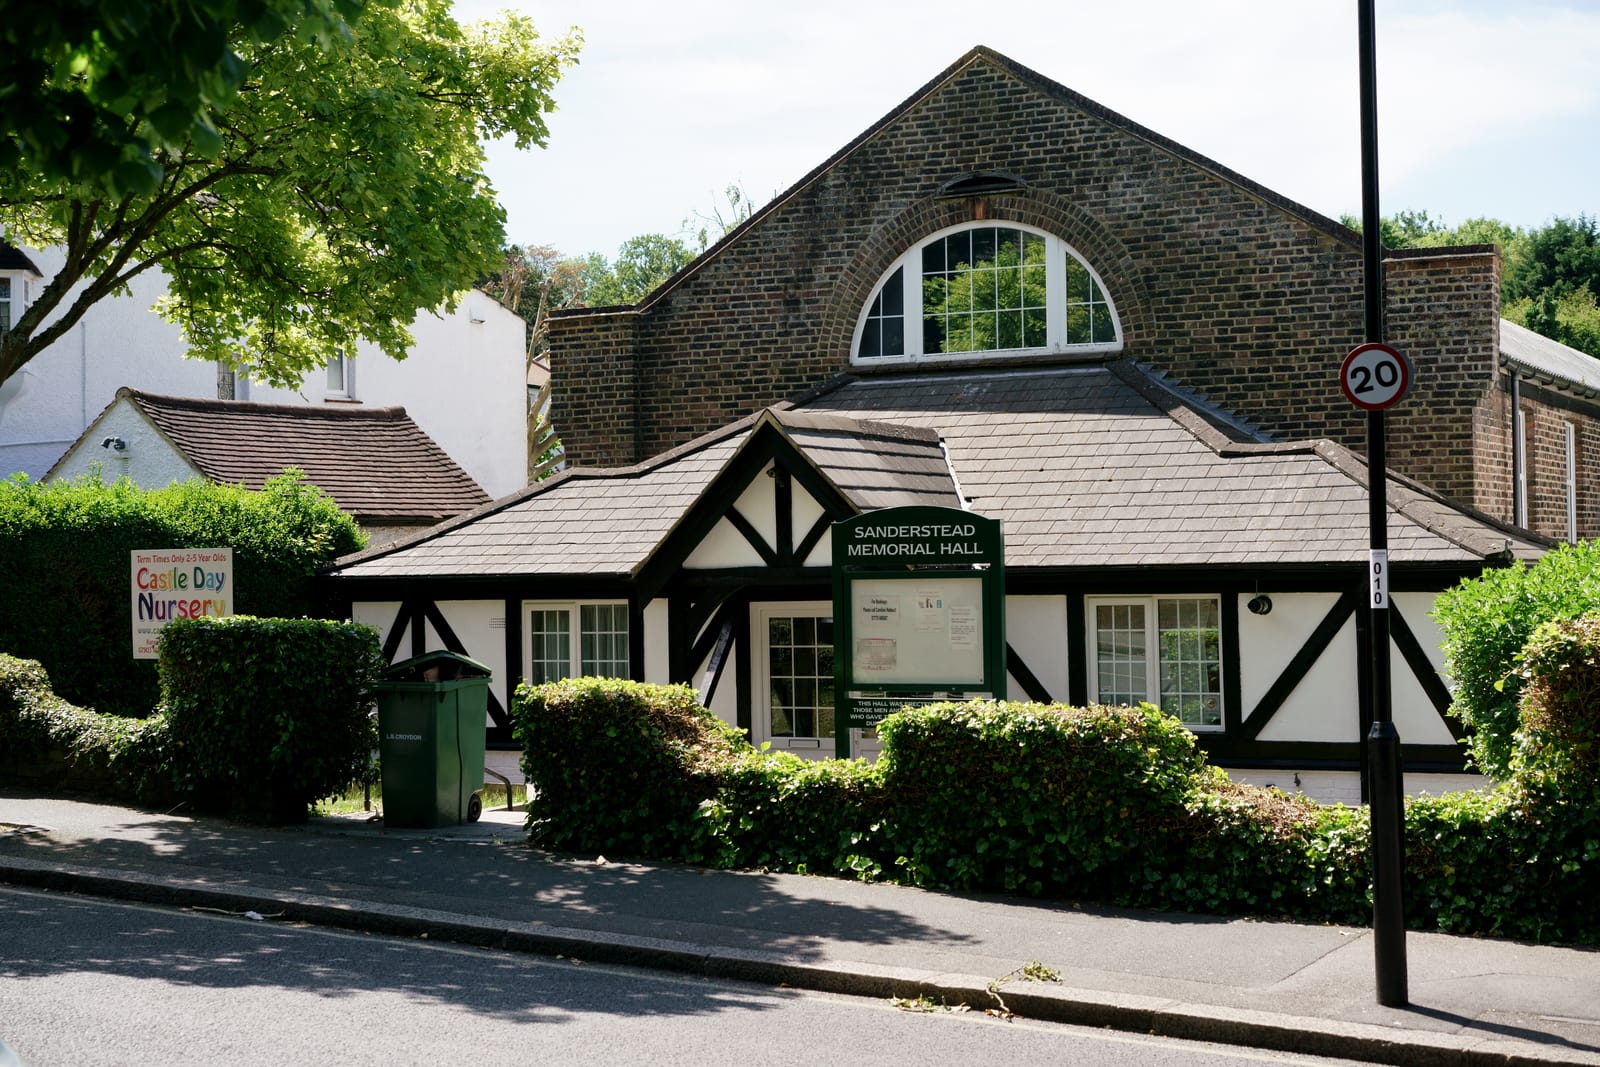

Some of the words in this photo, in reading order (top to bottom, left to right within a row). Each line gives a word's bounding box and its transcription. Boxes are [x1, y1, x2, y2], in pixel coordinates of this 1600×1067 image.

[1350, 360, 1398, 394] 20
[854, 524, 976, 538] SANDERSTEAD
[137, 555, 152, 564] Term
[152, 555, 170, 563] Times
[171, 554, 185, 563] Only
[186, 554, 197, 562] 2-5
[198, 553, 211, 562] Year
[212, 553, 226, 562] Olds
[848, 543, 935, 556] MEMORIAL
[940, 542, 983, 554] HALL
[137, 566, 188, 591] Castle
[193, 566, 225, 592] Day
[138, 592, 225, 620] Nursery
